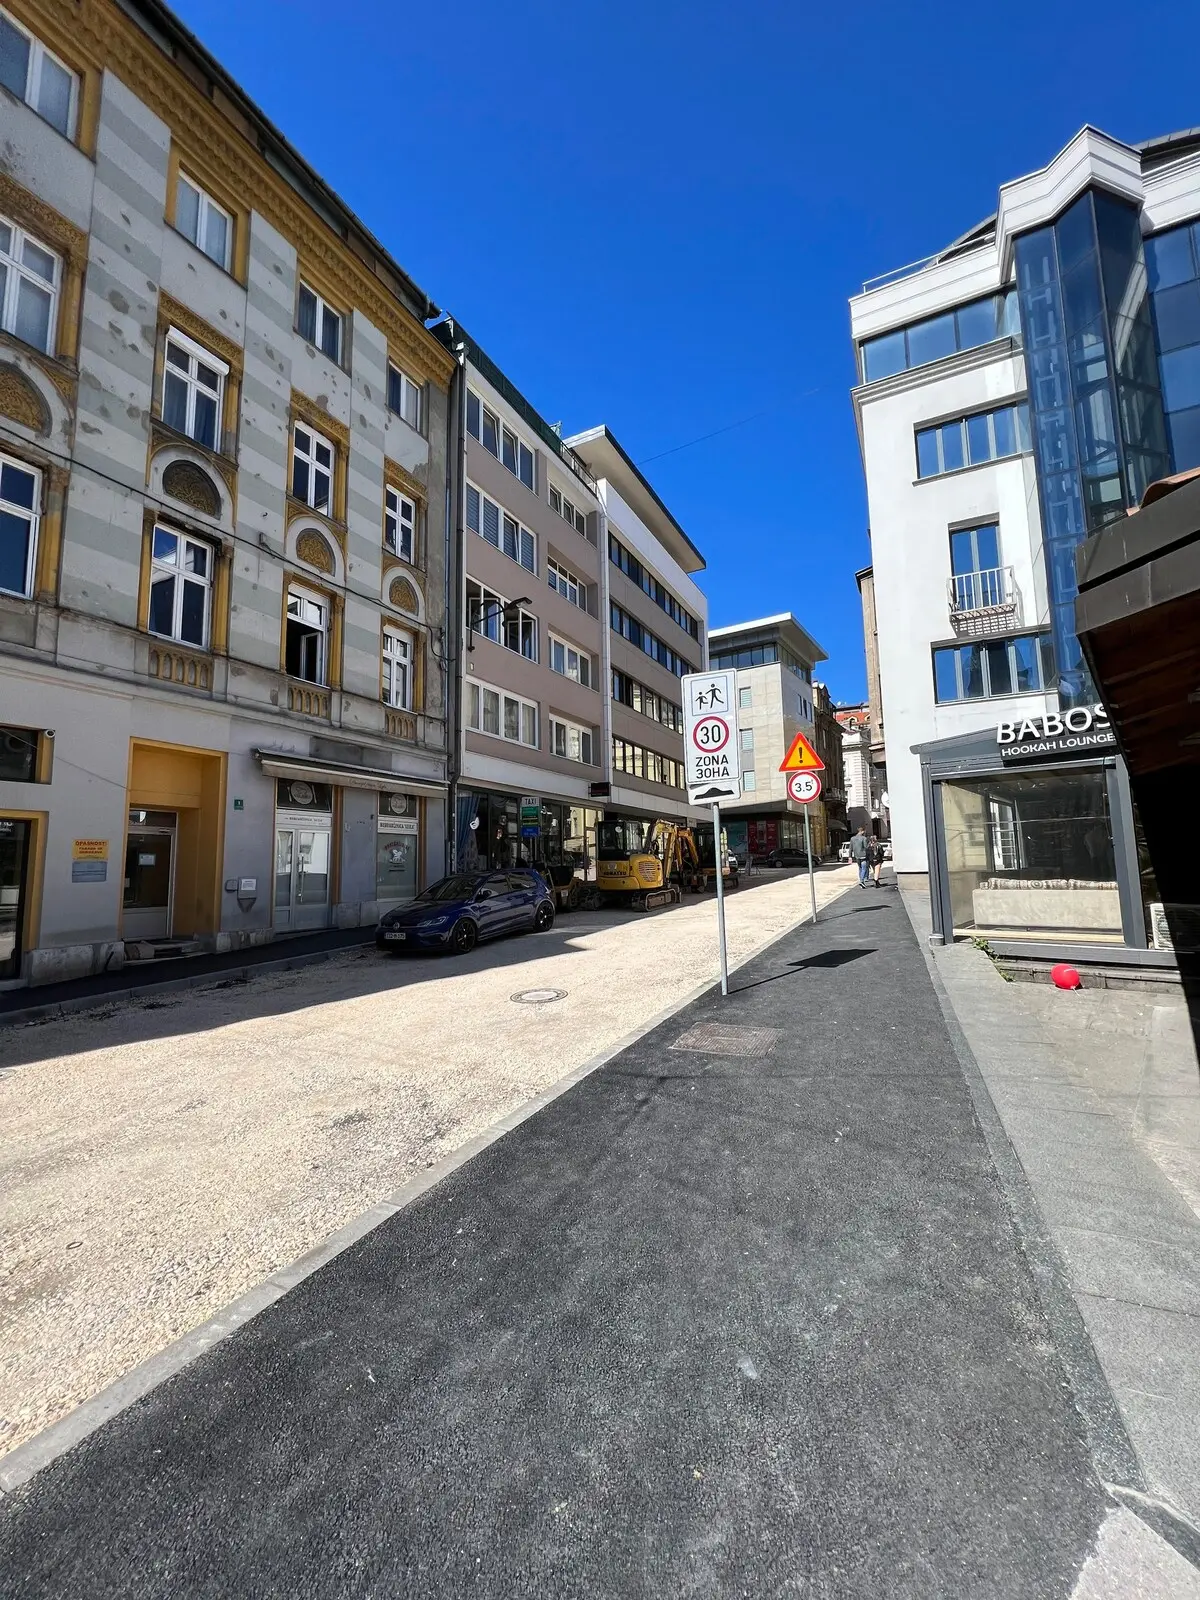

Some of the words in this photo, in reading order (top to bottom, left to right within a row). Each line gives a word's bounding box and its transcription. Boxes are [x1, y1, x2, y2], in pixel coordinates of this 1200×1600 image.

[996, 702, 1112, 744] BABOS
[700, 724, 721, 744] 30
[1001, 741, 1057, 757] HOOKAH
[1059, 732, 1116, 749] LOUNGE
[695, 754, 729, 767] ZONA
[696, 766, 730, 779] ЗОНА
